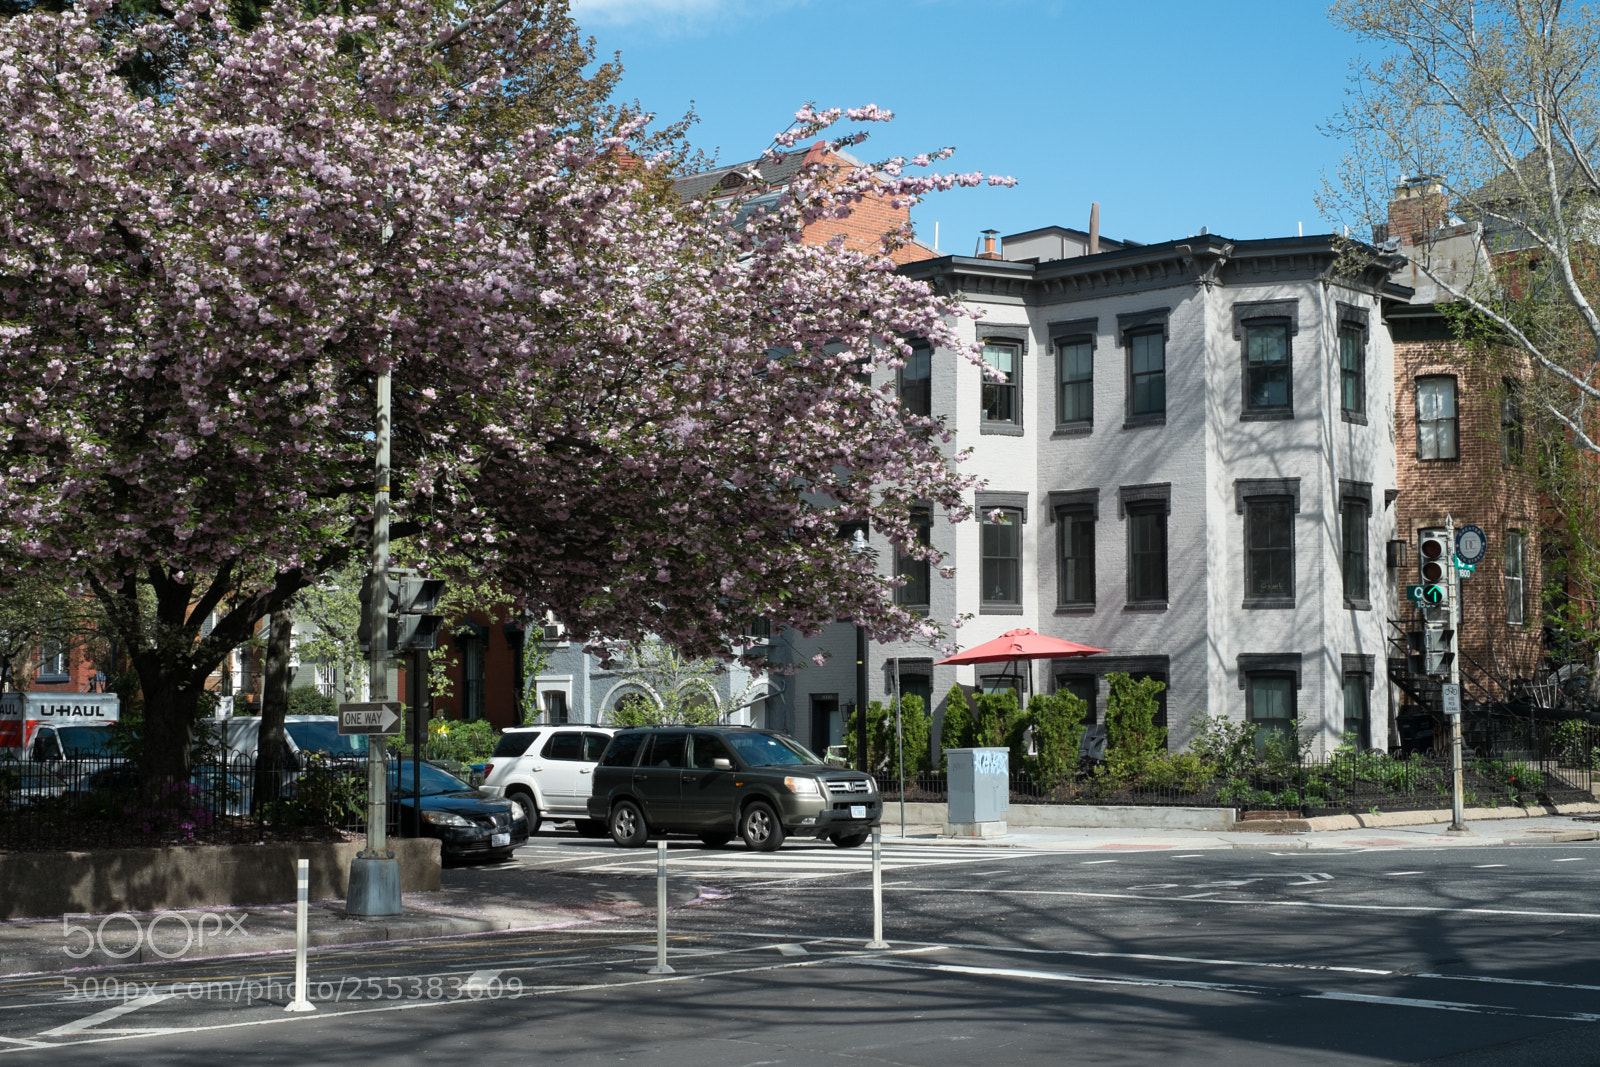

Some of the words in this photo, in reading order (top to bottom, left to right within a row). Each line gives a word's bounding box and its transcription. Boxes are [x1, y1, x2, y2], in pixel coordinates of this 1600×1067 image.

[40, 705, 105, 717] U-HAUL
[345, 712, 362, 725] ONE
[364, 712, 383, 725] WAY
